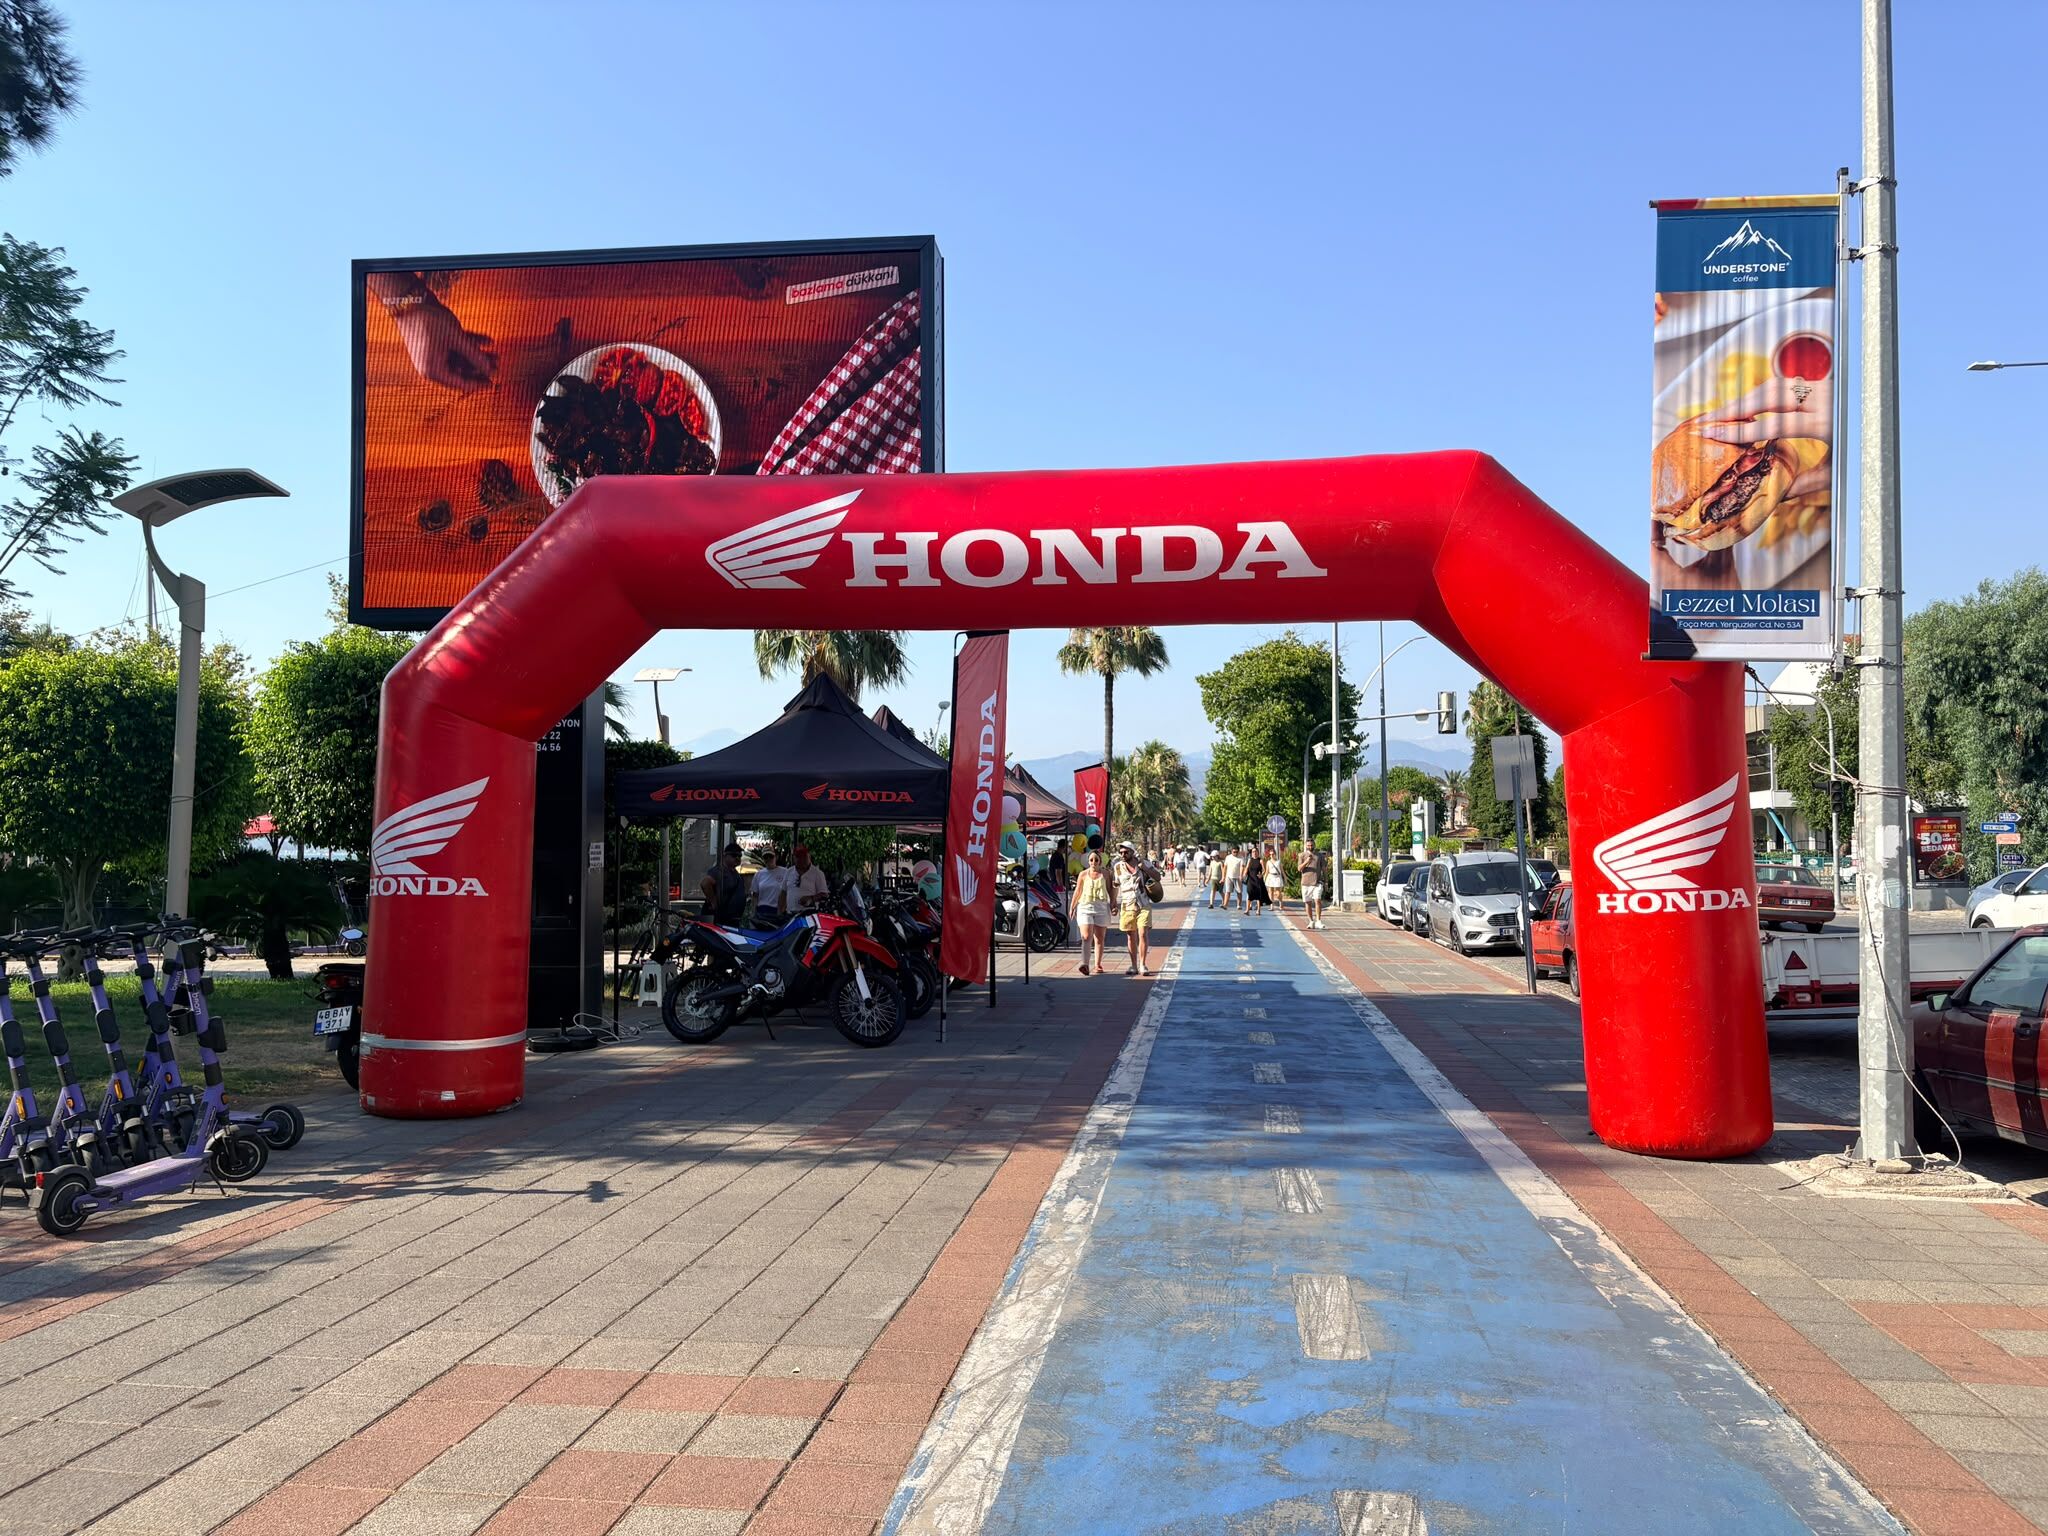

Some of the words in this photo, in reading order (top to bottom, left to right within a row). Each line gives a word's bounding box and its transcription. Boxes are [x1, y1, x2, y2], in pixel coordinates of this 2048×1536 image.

[1732, 275, 1759, 283] coffee
[791, 280, 844, 298] bazlama
[842, 520, 1328, 588] HONDA
[1664, 593, 1734, 613] Lezzet
[1742, 593, 1816, 613] Molası
[1679, 621, 1699, 629] Foça
[550, 743, 561, 751] 56
[967, 689, 997, 858] HONDA
[675, 788, 760, 800] HONDA
[828, 789, 914, 803] HONDA
[1920, 832, 1942, 845] 50
[1920, 843, 1956, 852] BEDAVA!
[369, 876, 489, 896] HONDA
[1597, 887, 1751, 914] HONDA
[319, 1010, 331, 1020] 48
[332, 1007, 351, 1018] BAY
[325, 1018, 343, 1029] 371
